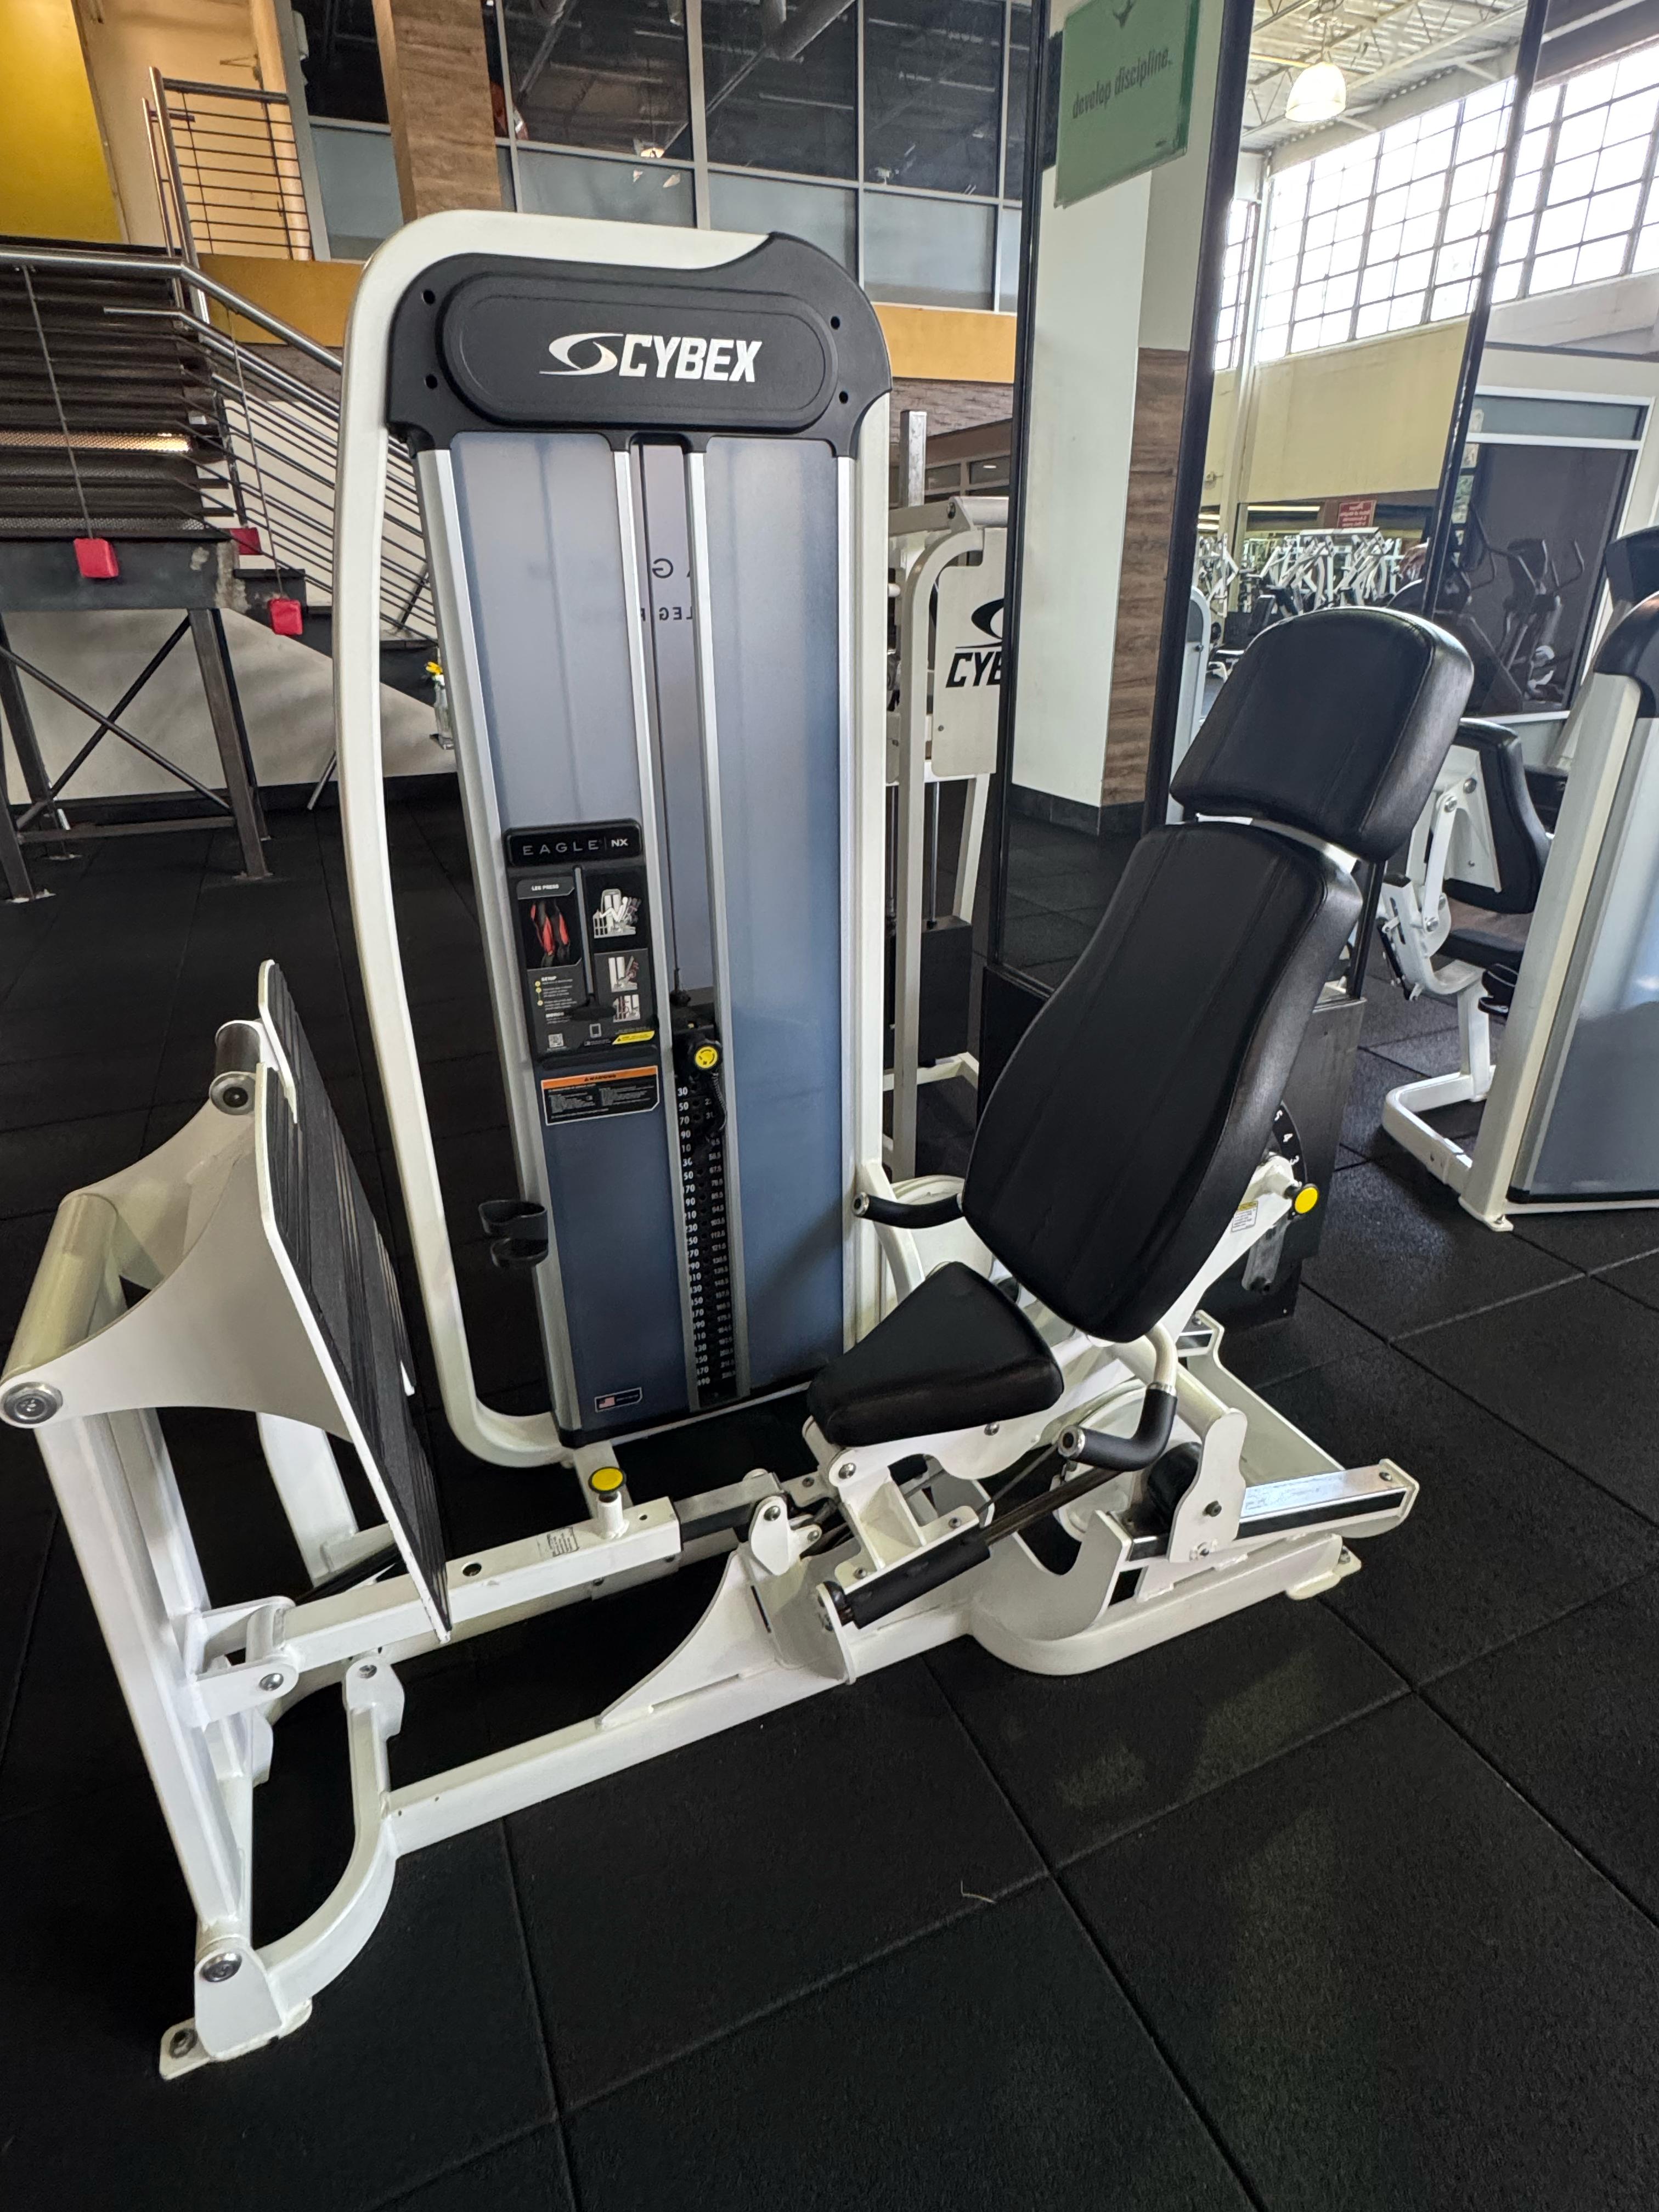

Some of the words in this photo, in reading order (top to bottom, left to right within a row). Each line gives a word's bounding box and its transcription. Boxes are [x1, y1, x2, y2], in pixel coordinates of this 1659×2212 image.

[1073, 80, 1111, 119] develop
[1114, 47, 1173, 96] discipline.
[619, 334, 763, 382] CYBEX
[945, 651, 1002, 688] CYB
[522, 839, 600, 856] EAGLE
[611, 838, 629, 848] NX
[678, 1086, 688, 1096] 30
[679, 1102, 689, 1111] 50
[680, 1116, 690, 1125] 70
[681, 1130, 691, 1139] 90
[681, 1143, 691, 1153] 10
[682, 1157, 692, 1167] 30
[684, 1171, 693, 1181] 50
[686, 1184, 695, 1193] 70
[685, 1197, 696, 1206] 90
[685, 1210, 697, 1220] 10
